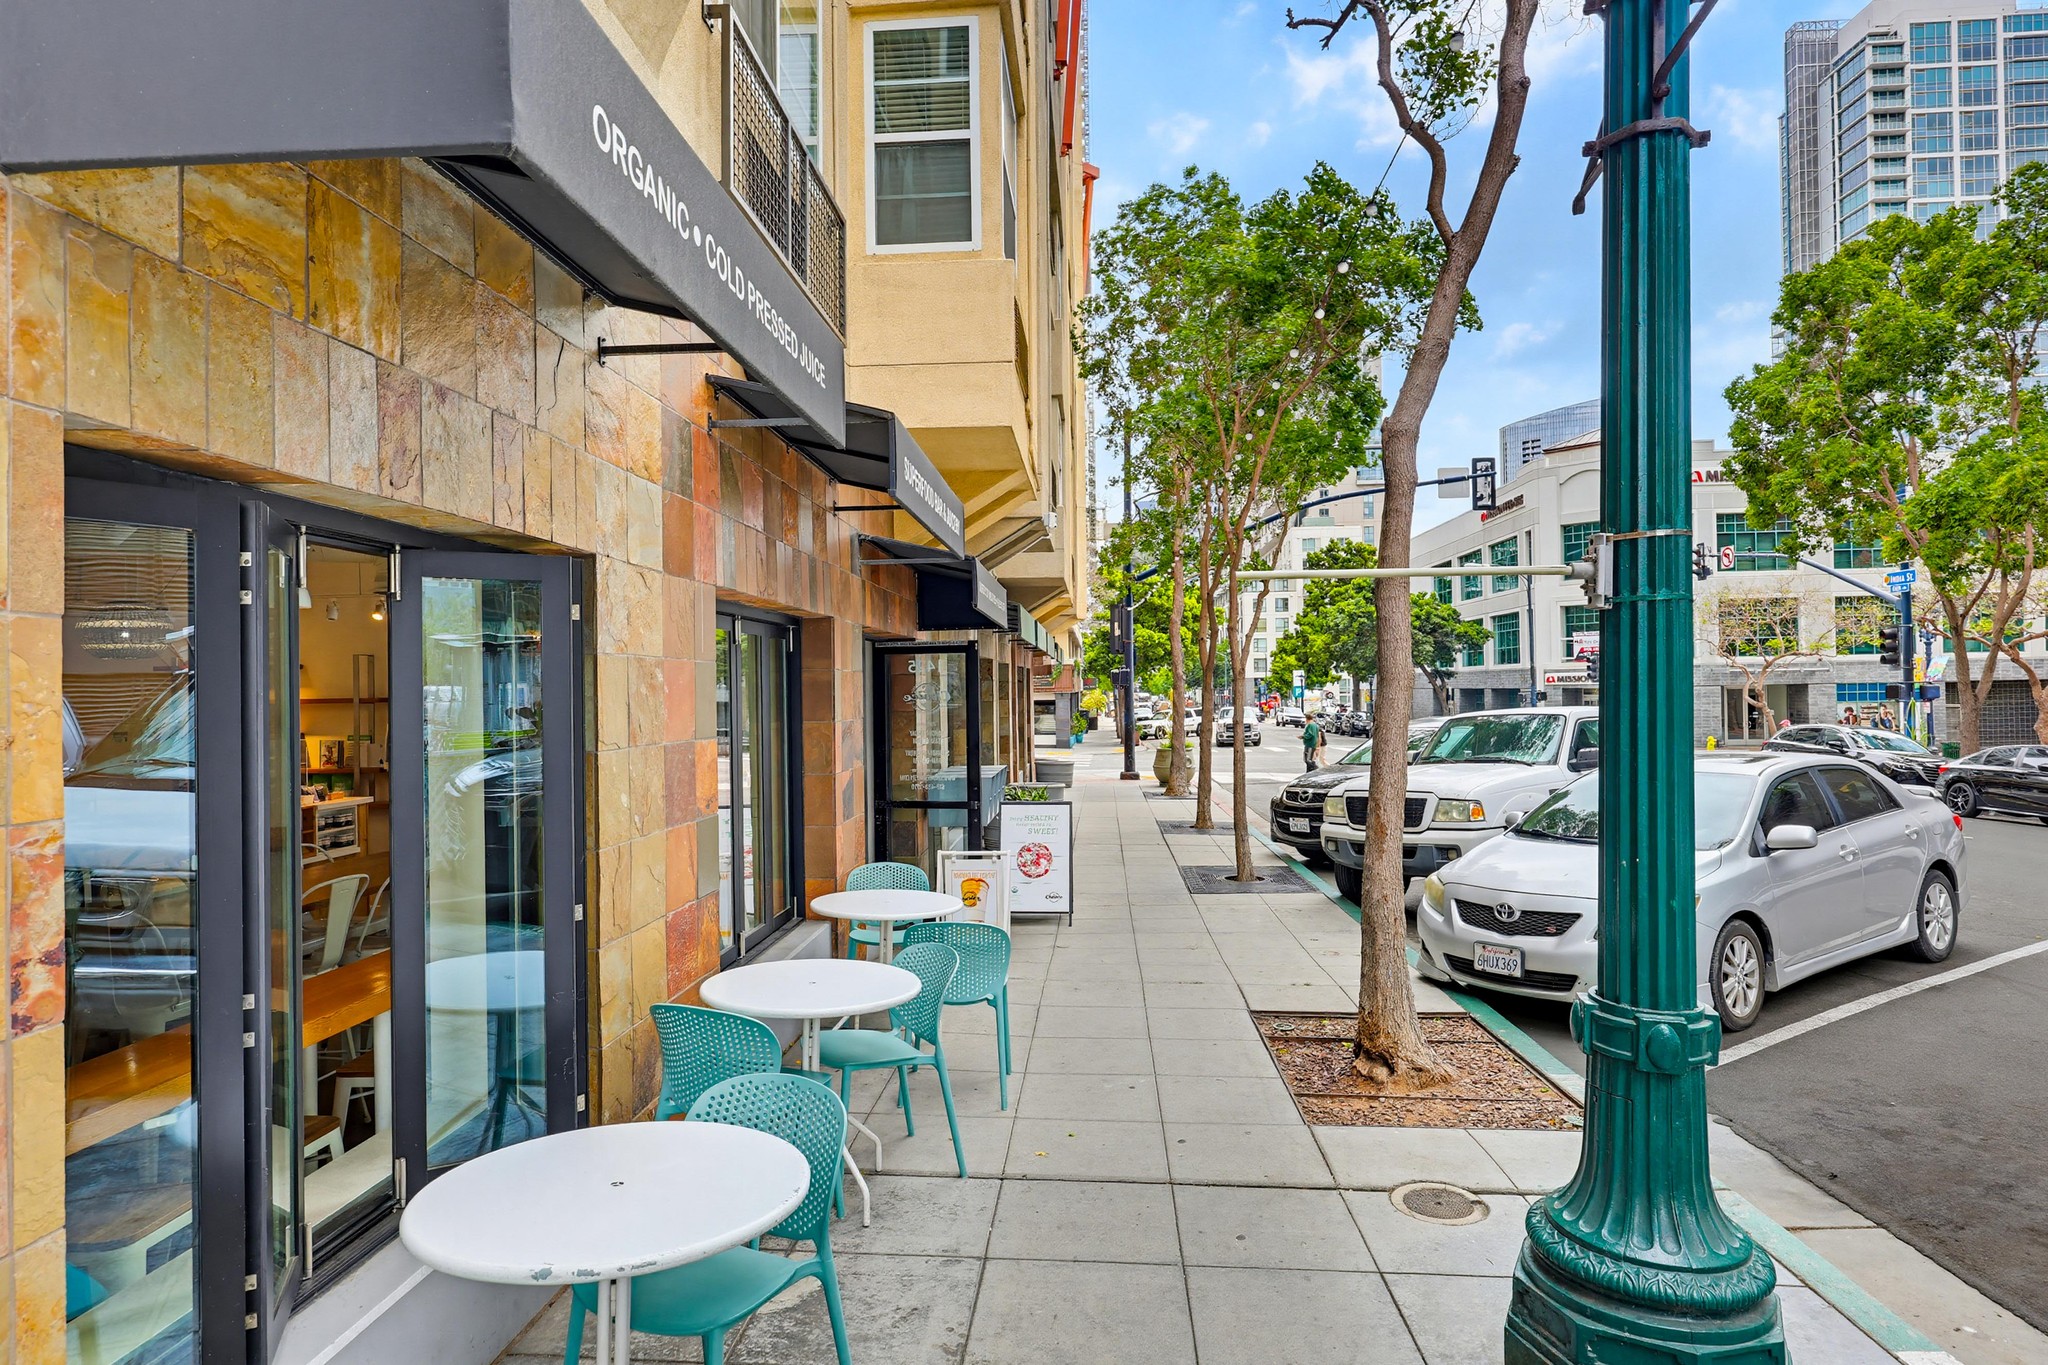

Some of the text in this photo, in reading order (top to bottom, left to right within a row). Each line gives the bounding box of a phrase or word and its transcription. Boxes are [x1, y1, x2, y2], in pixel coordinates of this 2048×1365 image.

[592, 104, 826, 389] ORGANIC COLD PRESSED JUICE
[1477, 953, 1518, 972] 6HUX369
